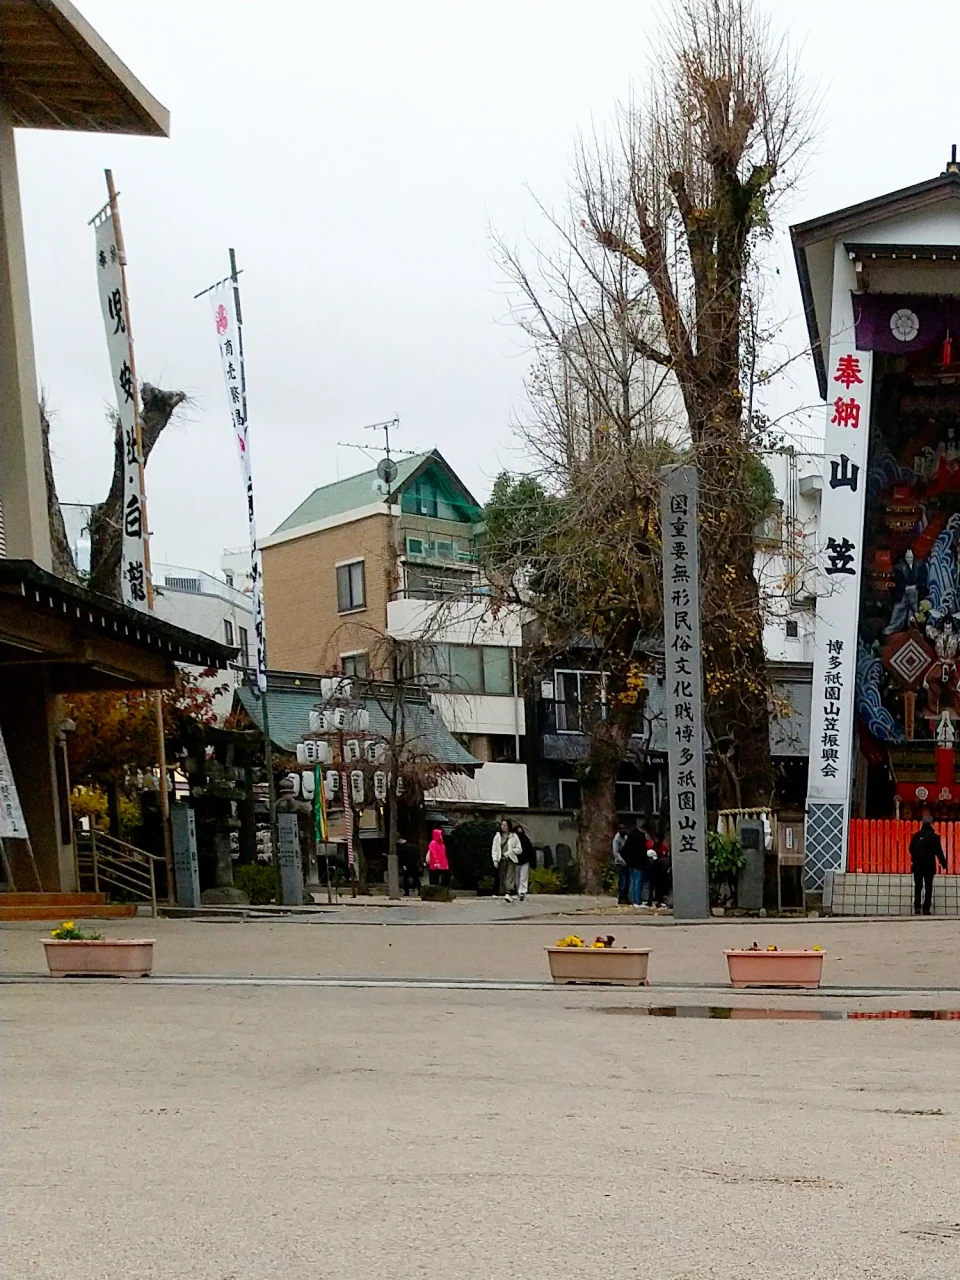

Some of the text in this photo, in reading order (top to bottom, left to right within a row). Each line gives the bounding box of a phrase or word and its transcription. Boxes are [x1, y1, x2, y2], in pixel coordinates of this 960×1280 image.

[819, 353, 865, 780] 奉納 山笠 博多祇園山笠振興会
